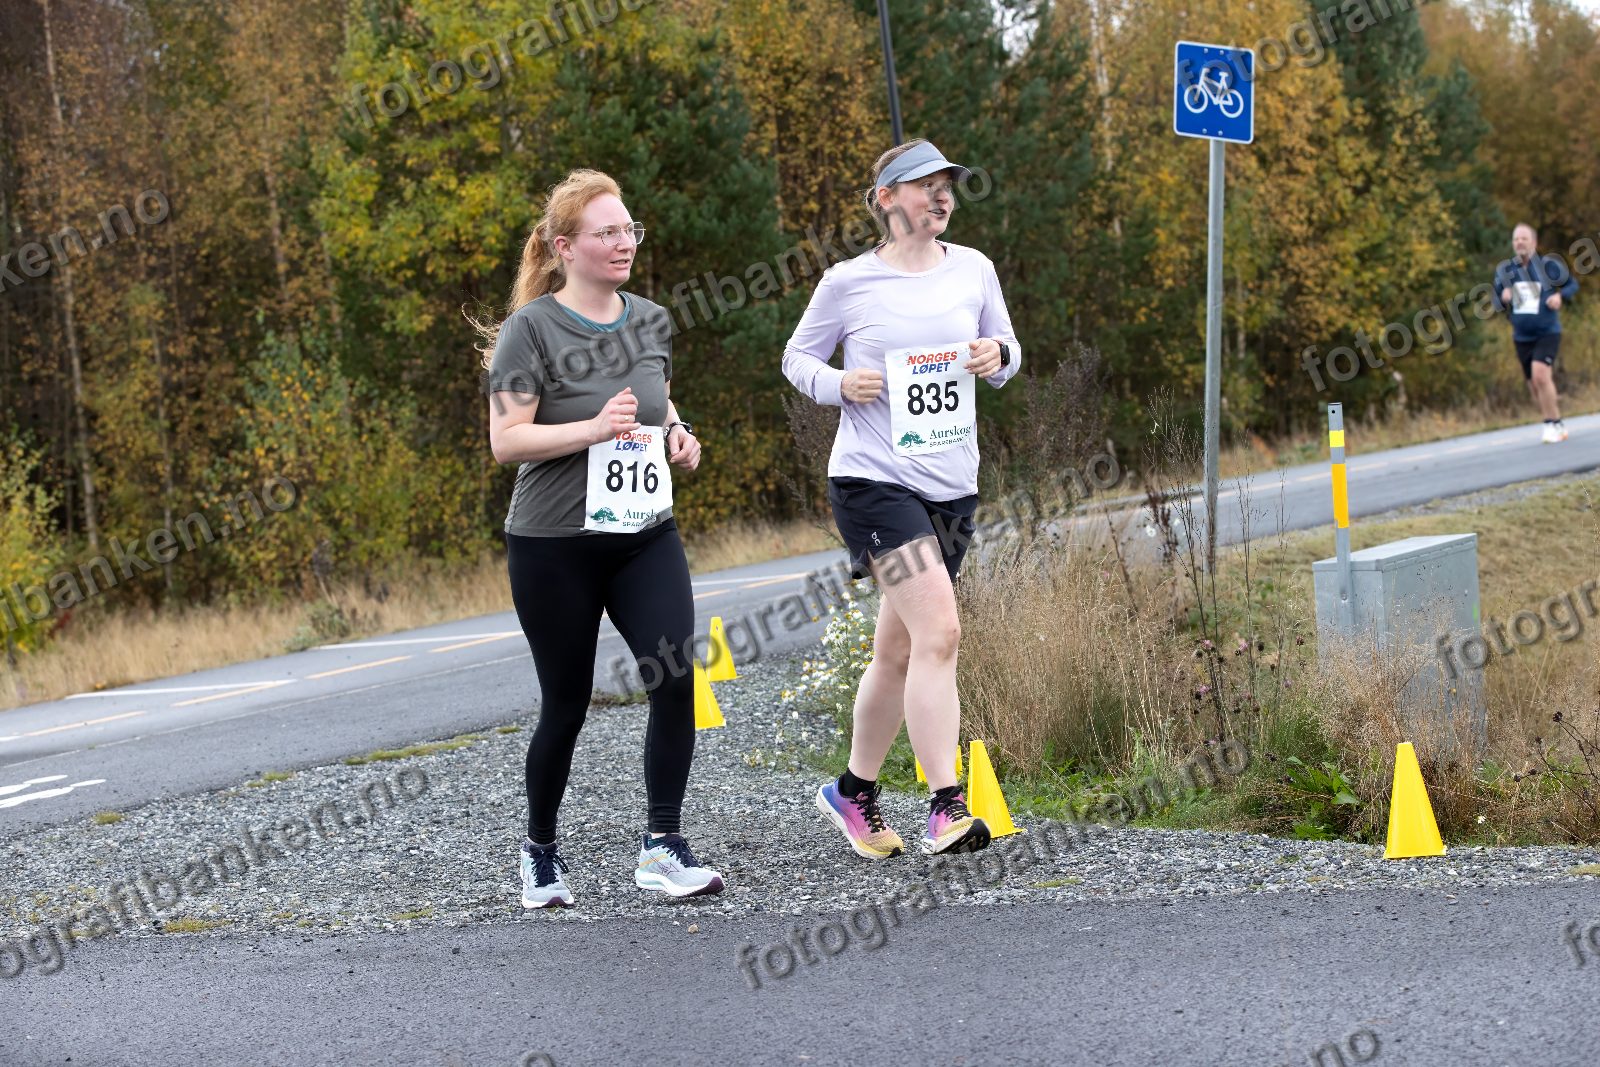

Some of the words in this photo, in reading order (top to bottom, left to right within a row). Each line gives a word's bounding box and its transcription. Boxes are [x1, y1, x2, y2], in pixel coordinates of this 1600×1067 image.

[907, 351, 958, 365] NORGES
[912, 362, 951, 375] LØPET
[907, 381, 959, 416] 835
[615, 441, 648, 452] LØPET
[606, 459, 659, 494] 816
